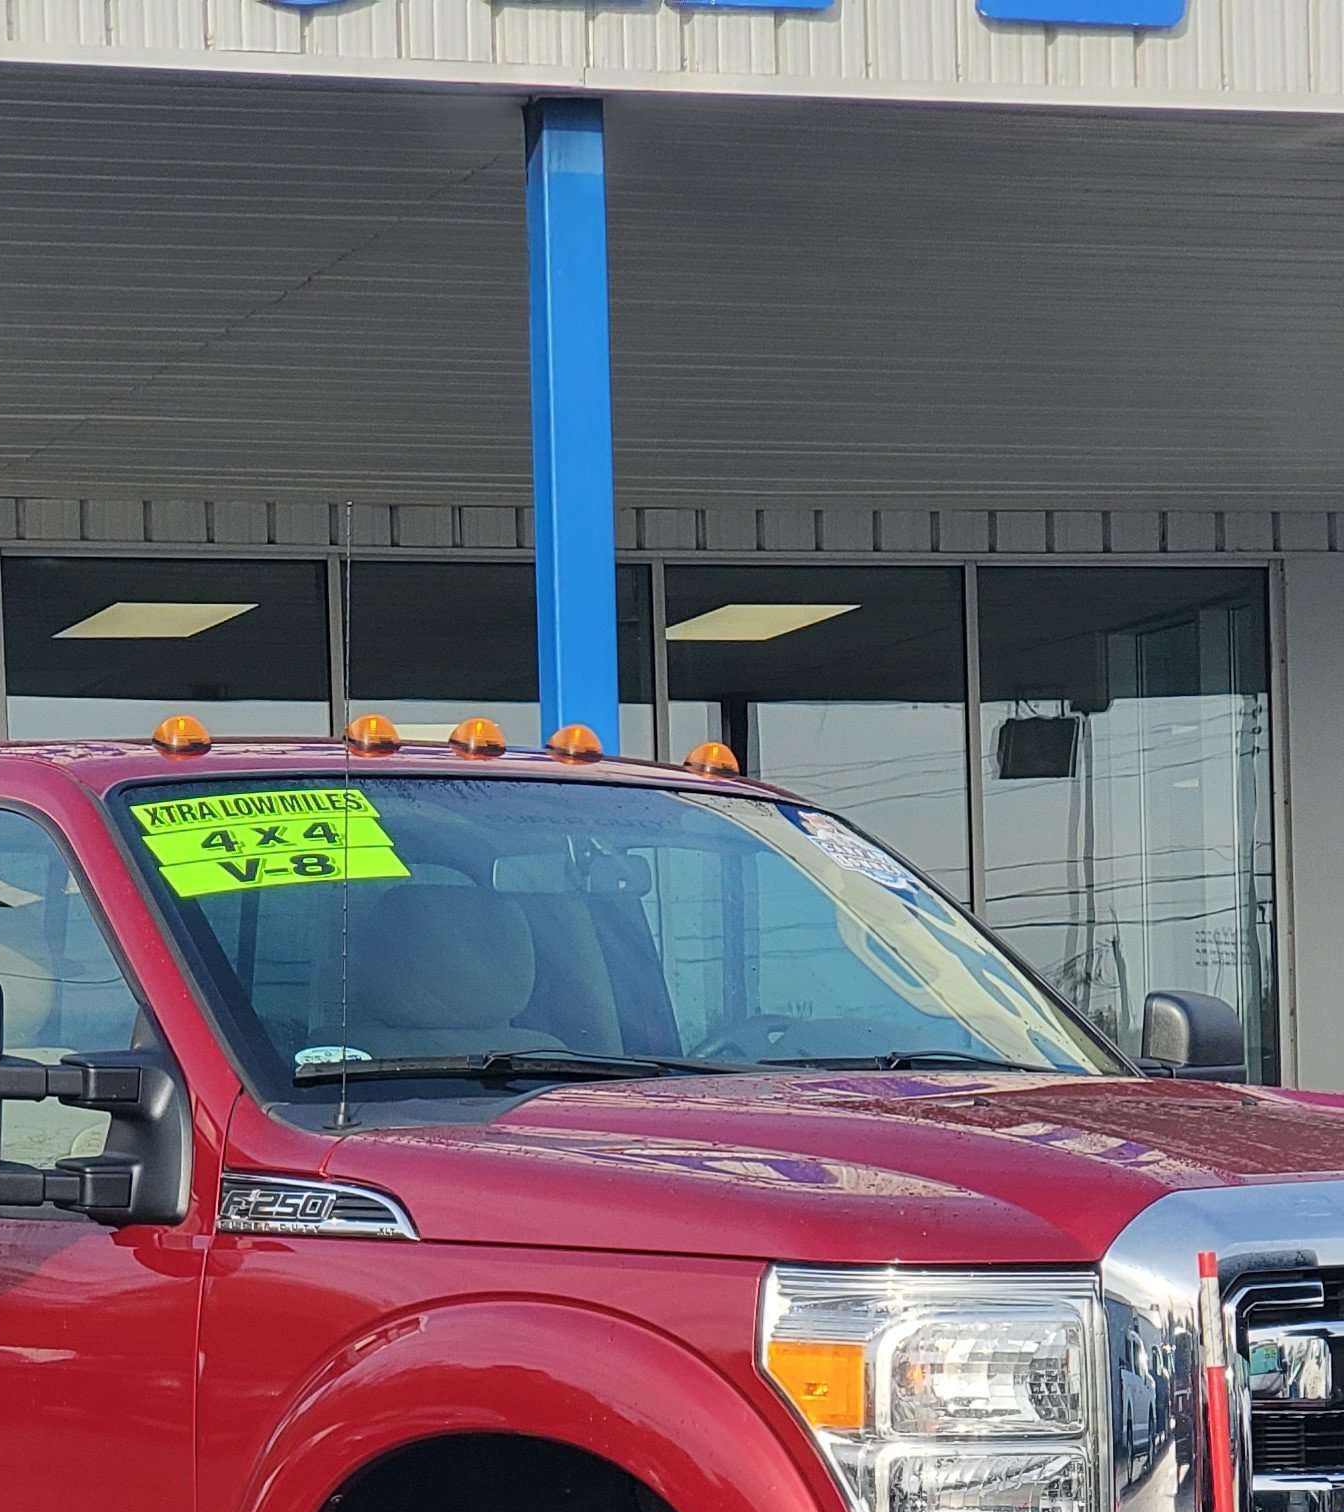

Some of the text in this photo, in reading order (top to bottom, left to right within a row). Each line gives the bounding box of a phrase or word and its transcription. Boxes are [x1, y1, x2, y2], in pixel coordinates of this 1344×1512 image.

[143, 791, 365, 827] XTRA LOW MILES
[217, 853, 340, 884] V-8
